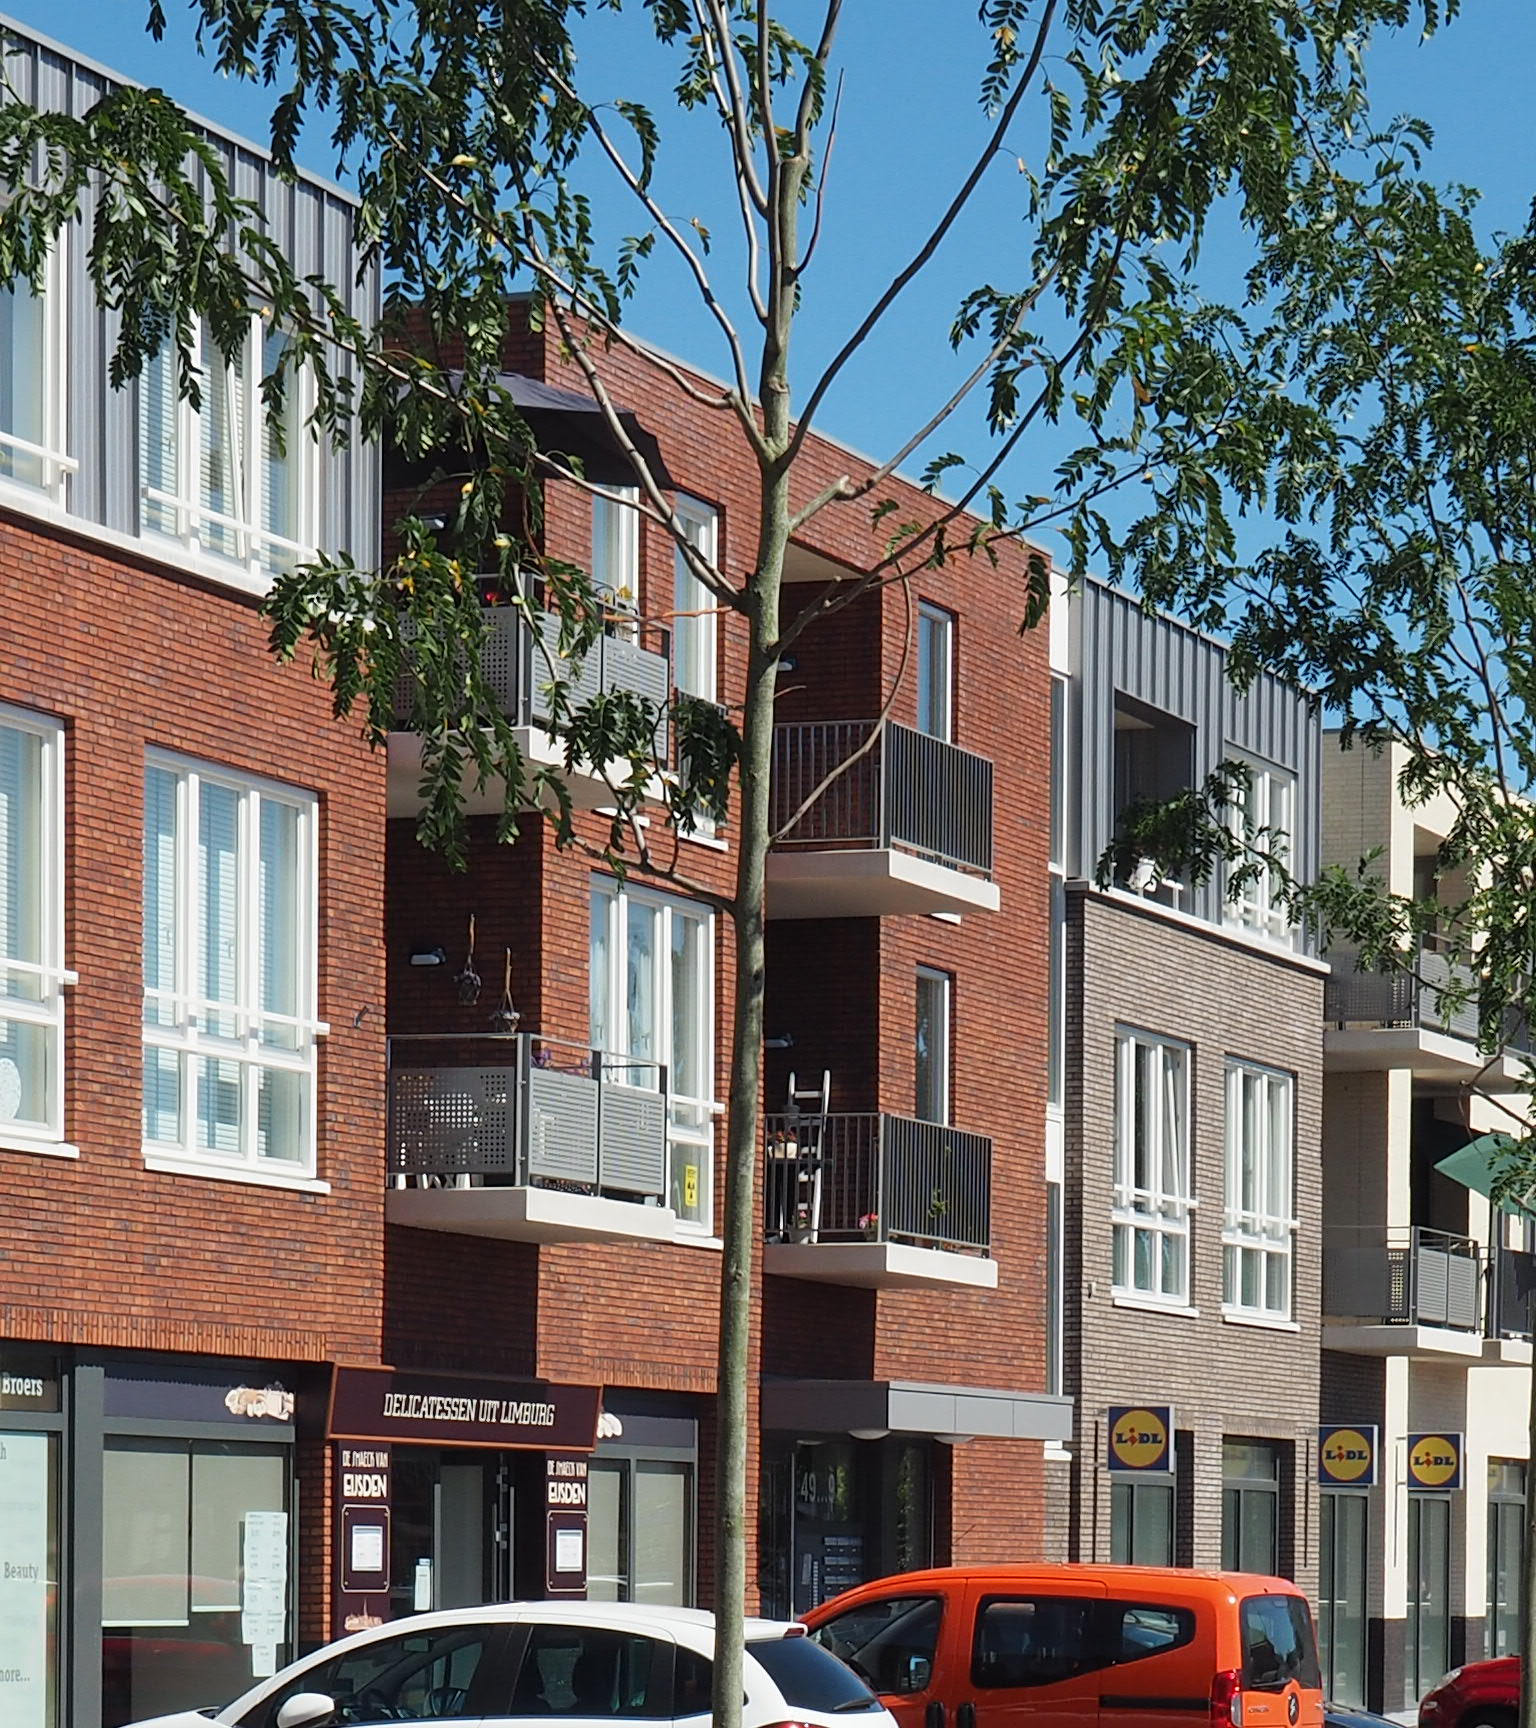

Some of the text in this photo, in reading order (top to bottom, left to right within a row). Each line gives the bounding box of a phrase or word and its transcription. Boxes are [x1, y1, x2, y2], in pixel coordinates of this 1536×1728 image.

[1, 1371, 44, 1397] Broers
[383, 1393, 556, 1426] DELICATESSEN UIT LIMBURG
[342, 1450, 351, 1467] DE
[375, 1452, 389, 1468] VAN
[547, 1459, 556, 1476] DE
[4, 1562, 40, 1583] Beauty
